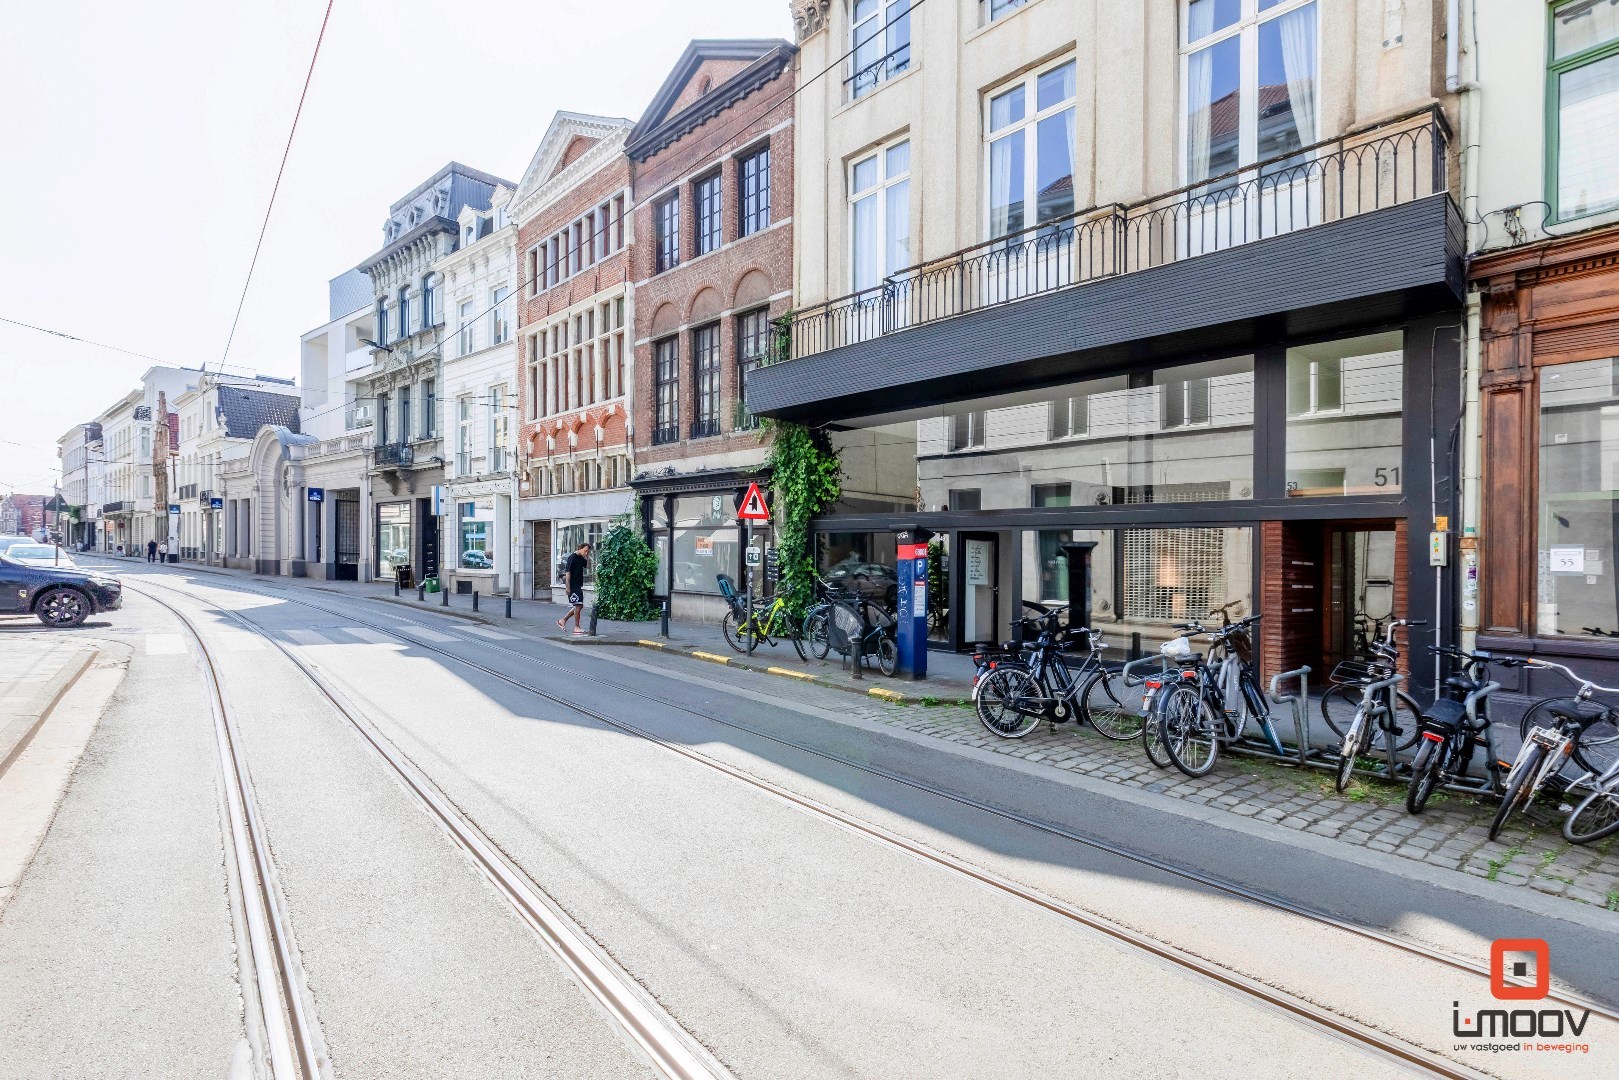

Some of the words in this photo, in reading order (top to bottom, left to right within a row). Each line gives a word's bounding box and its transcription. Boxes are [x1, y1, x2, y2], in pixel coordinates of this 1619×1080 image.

[1374, 467, 1400, 487] 51
[1287, 481, 1298, 491] 53
[917, 560, 923, 573] P
